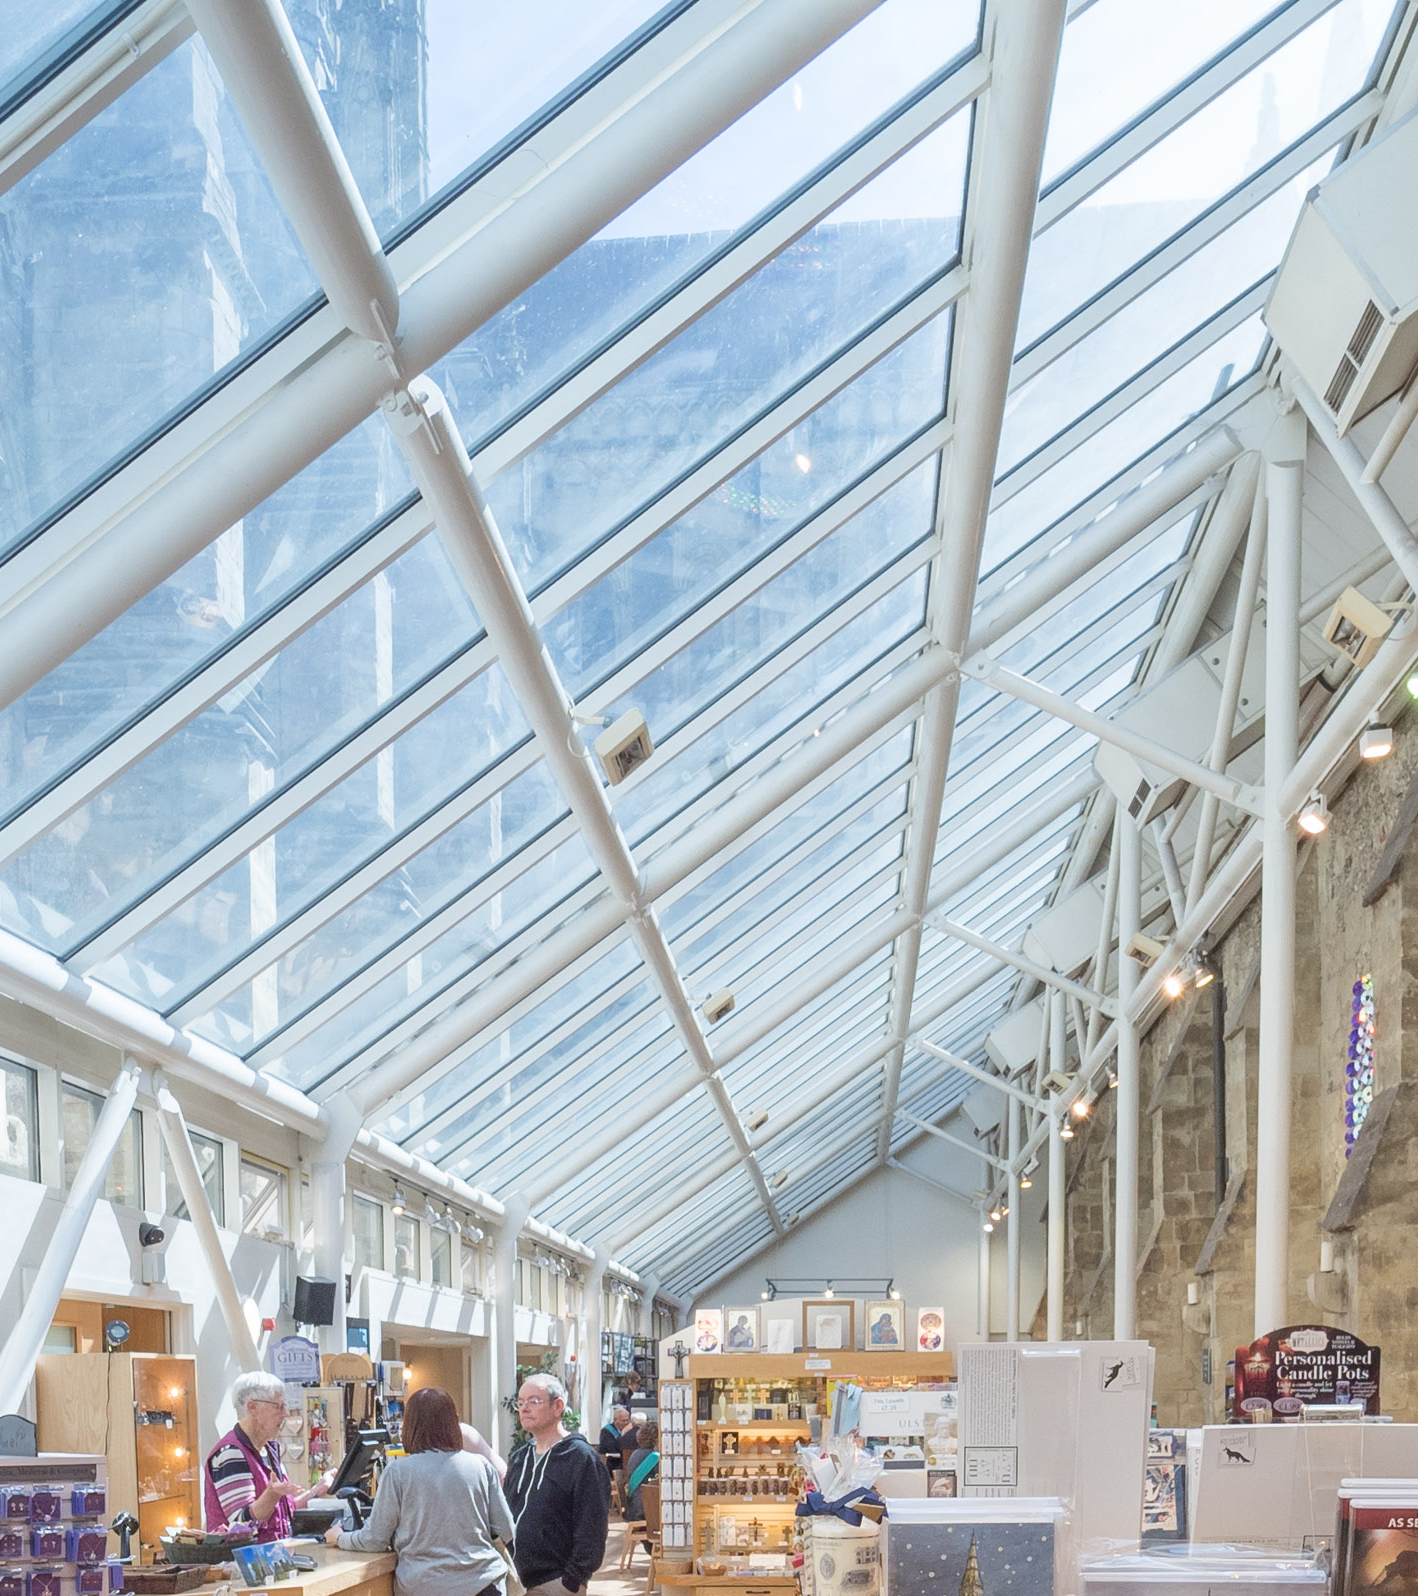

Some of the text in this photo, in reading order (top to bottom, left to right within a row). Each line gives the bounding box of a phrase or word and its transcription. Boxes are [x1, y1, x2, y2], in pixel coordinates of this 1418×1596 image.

[278, 1351, 313, 1363] GIFTS
[1275, 1350, 1372, 1366] Personalised
[1277, 1365, 1369, 1380] Candle Pots
[1388, 1518, 1404, 1528] AS
